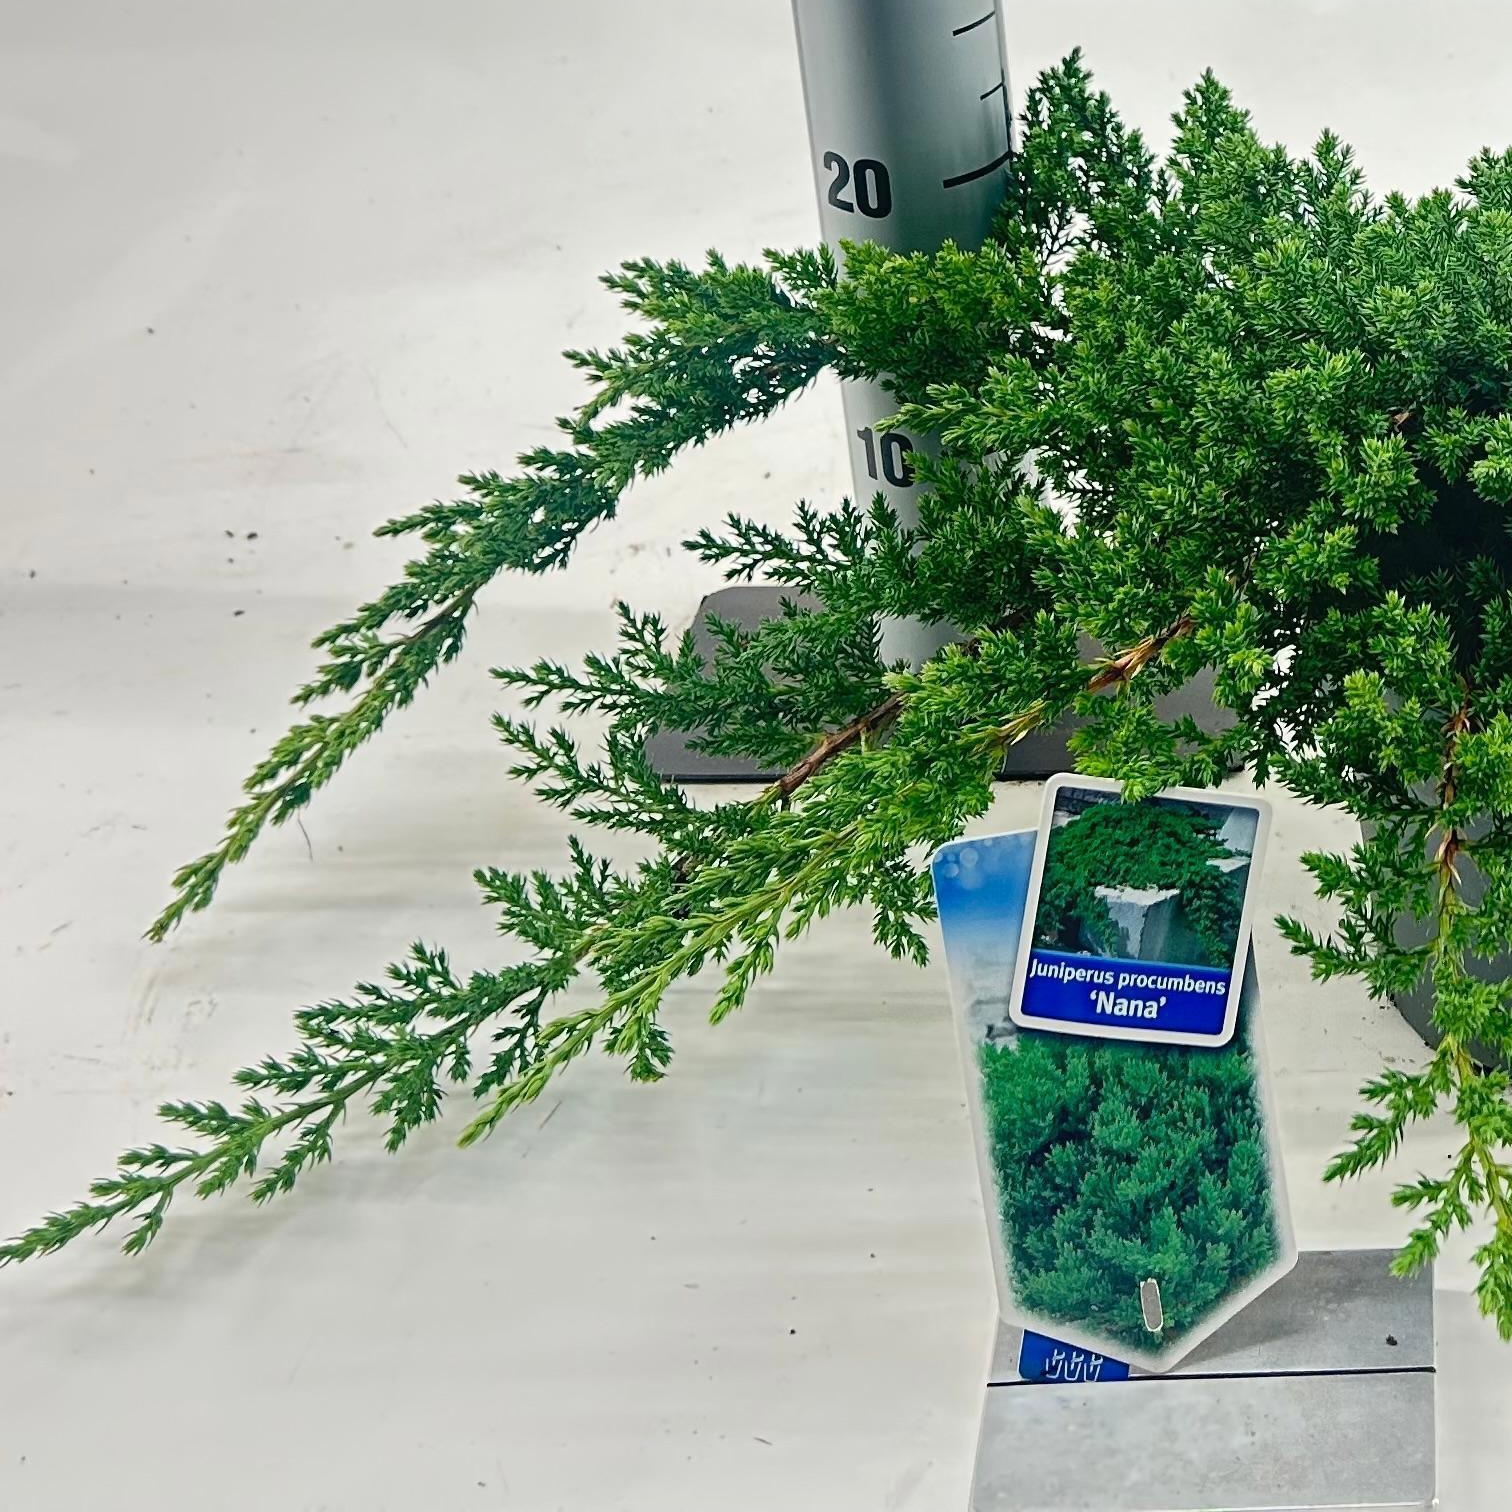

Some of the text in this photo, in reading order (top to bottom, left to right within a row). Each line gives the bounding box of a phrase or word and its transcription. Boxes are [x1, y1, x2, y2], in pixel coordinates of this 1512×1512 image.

[823, 150, 893, 219] 20
[857, 427, 916, 487] 10
[1030, 958, 1226, 995] Juniperus procumbens
